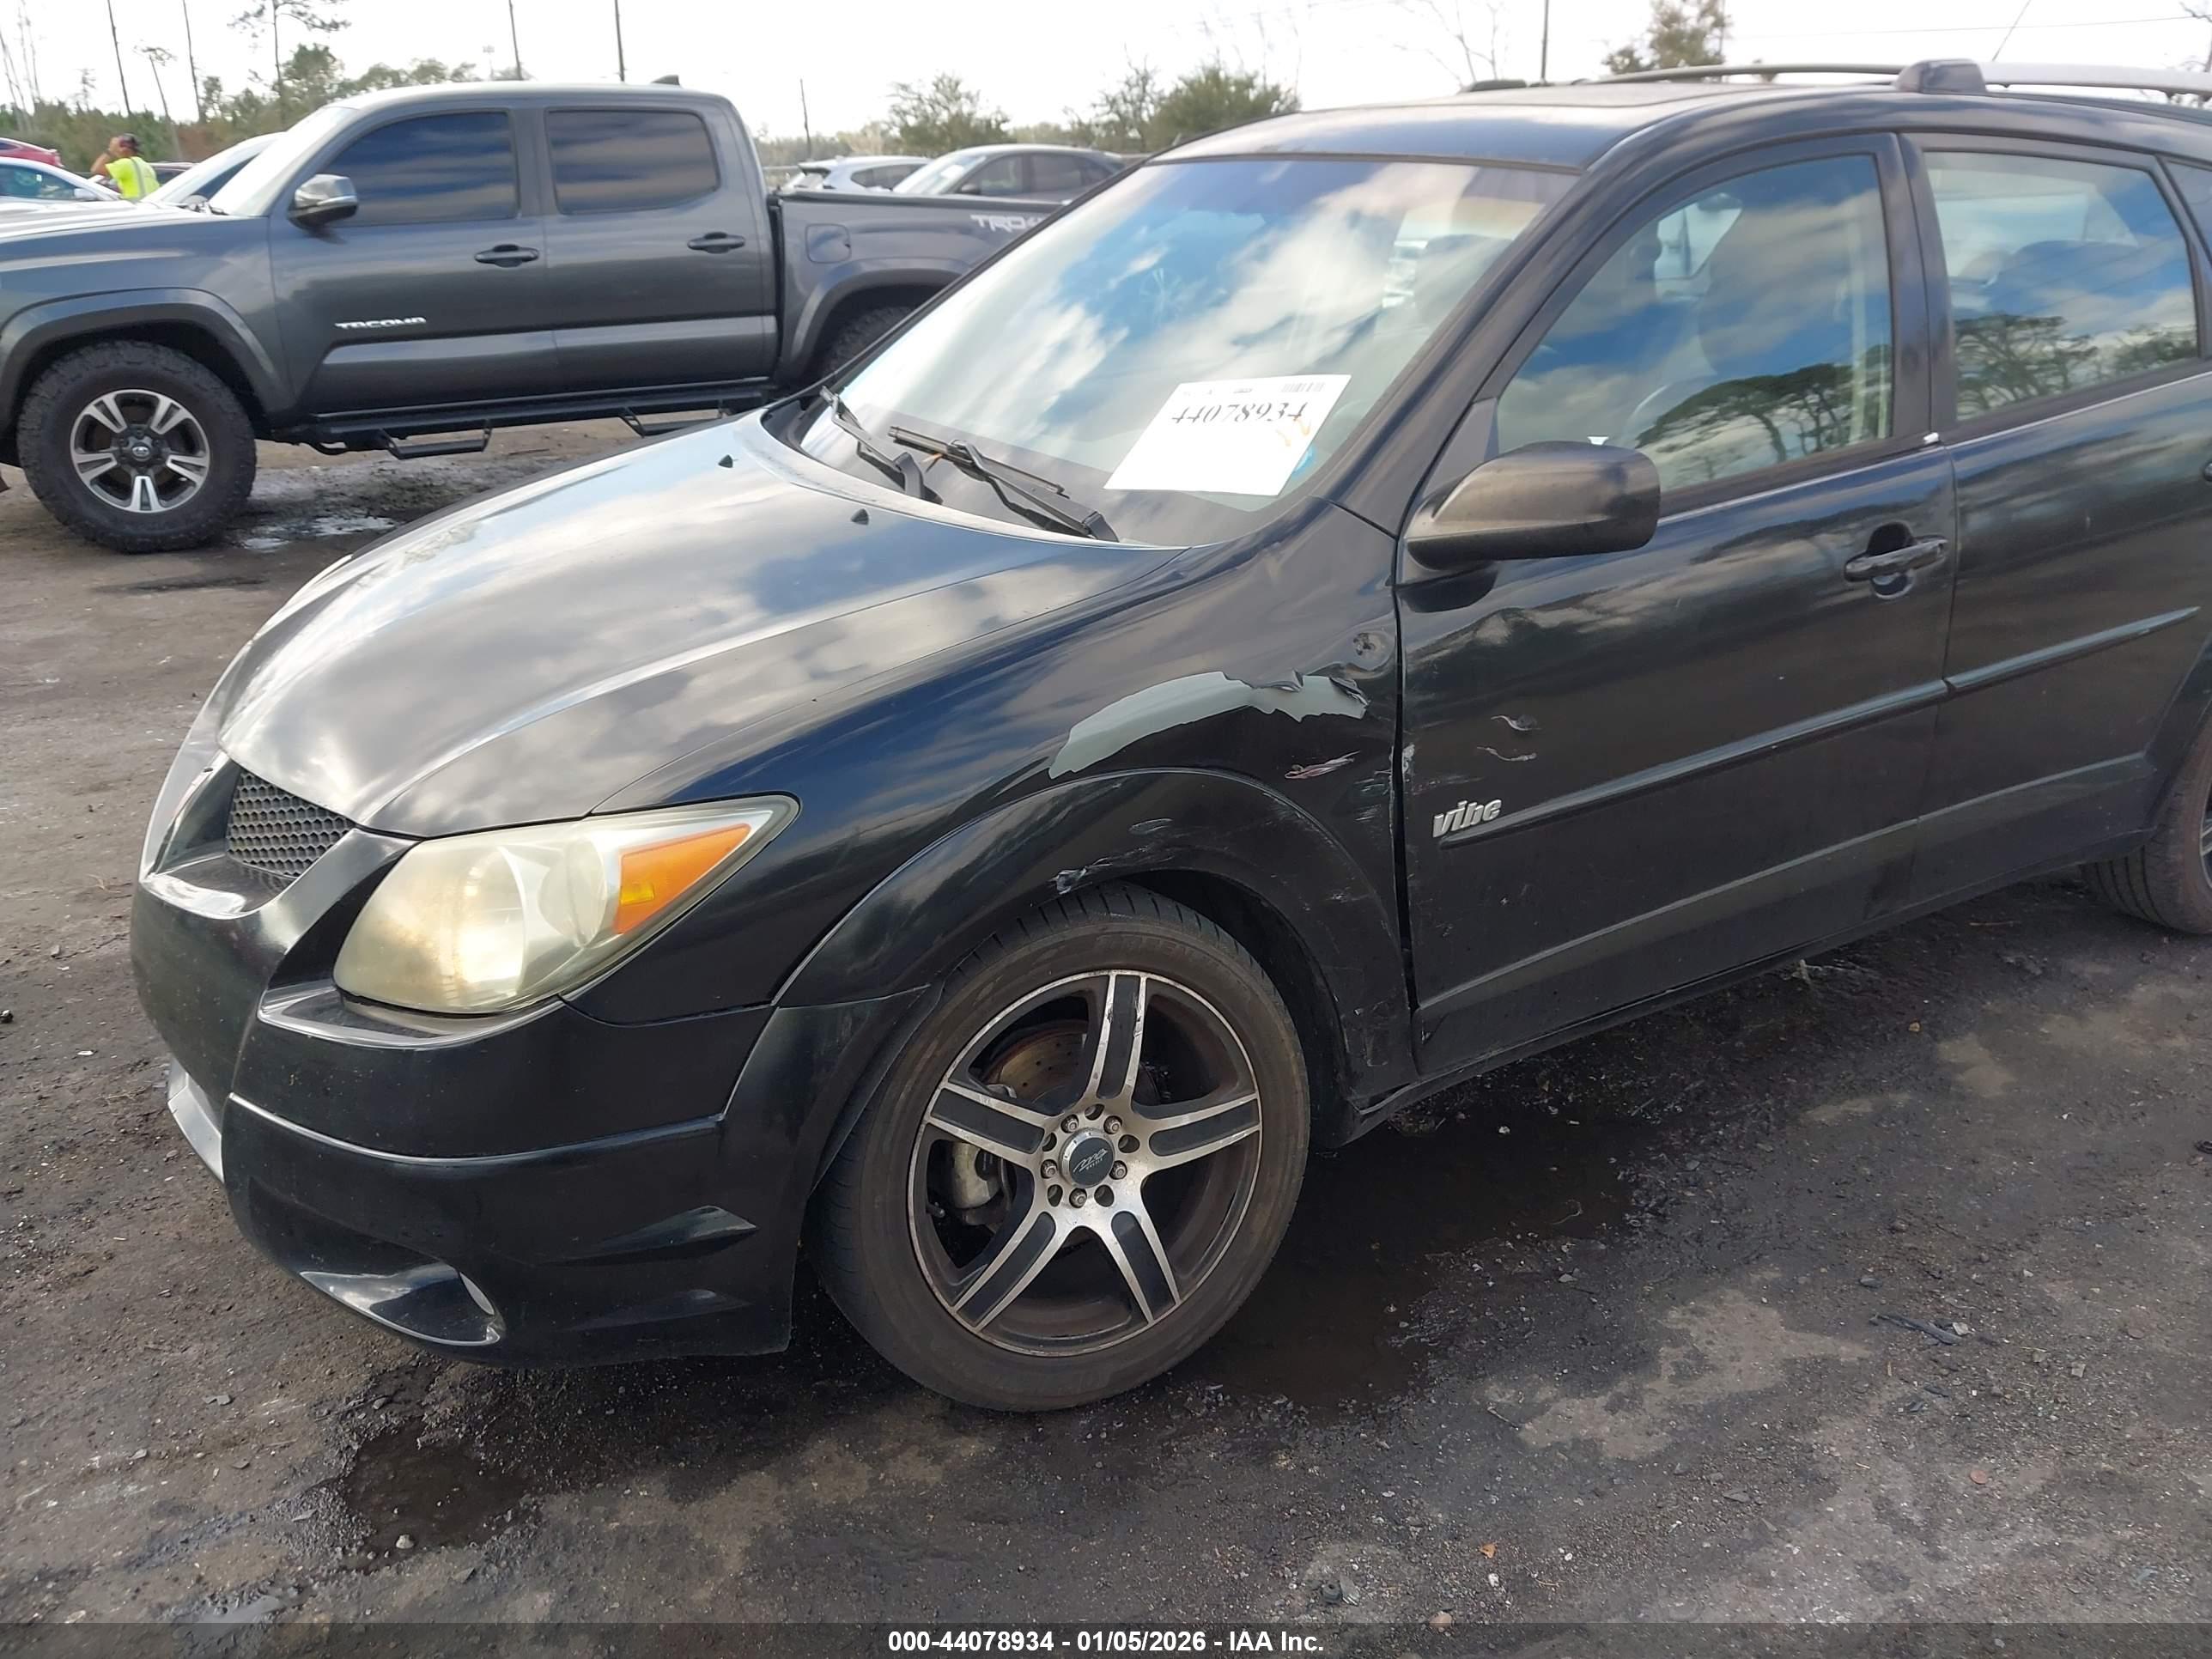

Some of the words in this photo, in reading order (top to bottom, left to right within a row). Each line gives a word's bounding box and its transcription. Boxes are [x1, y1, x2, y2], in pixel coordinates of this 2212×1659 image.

[969, 214, 1026, 233] TRD
[334, 316, 427, 330] TACOMA
[1171, 401, 1310, 424] 44078934
[1432, 799, 1502, 838] vibe
